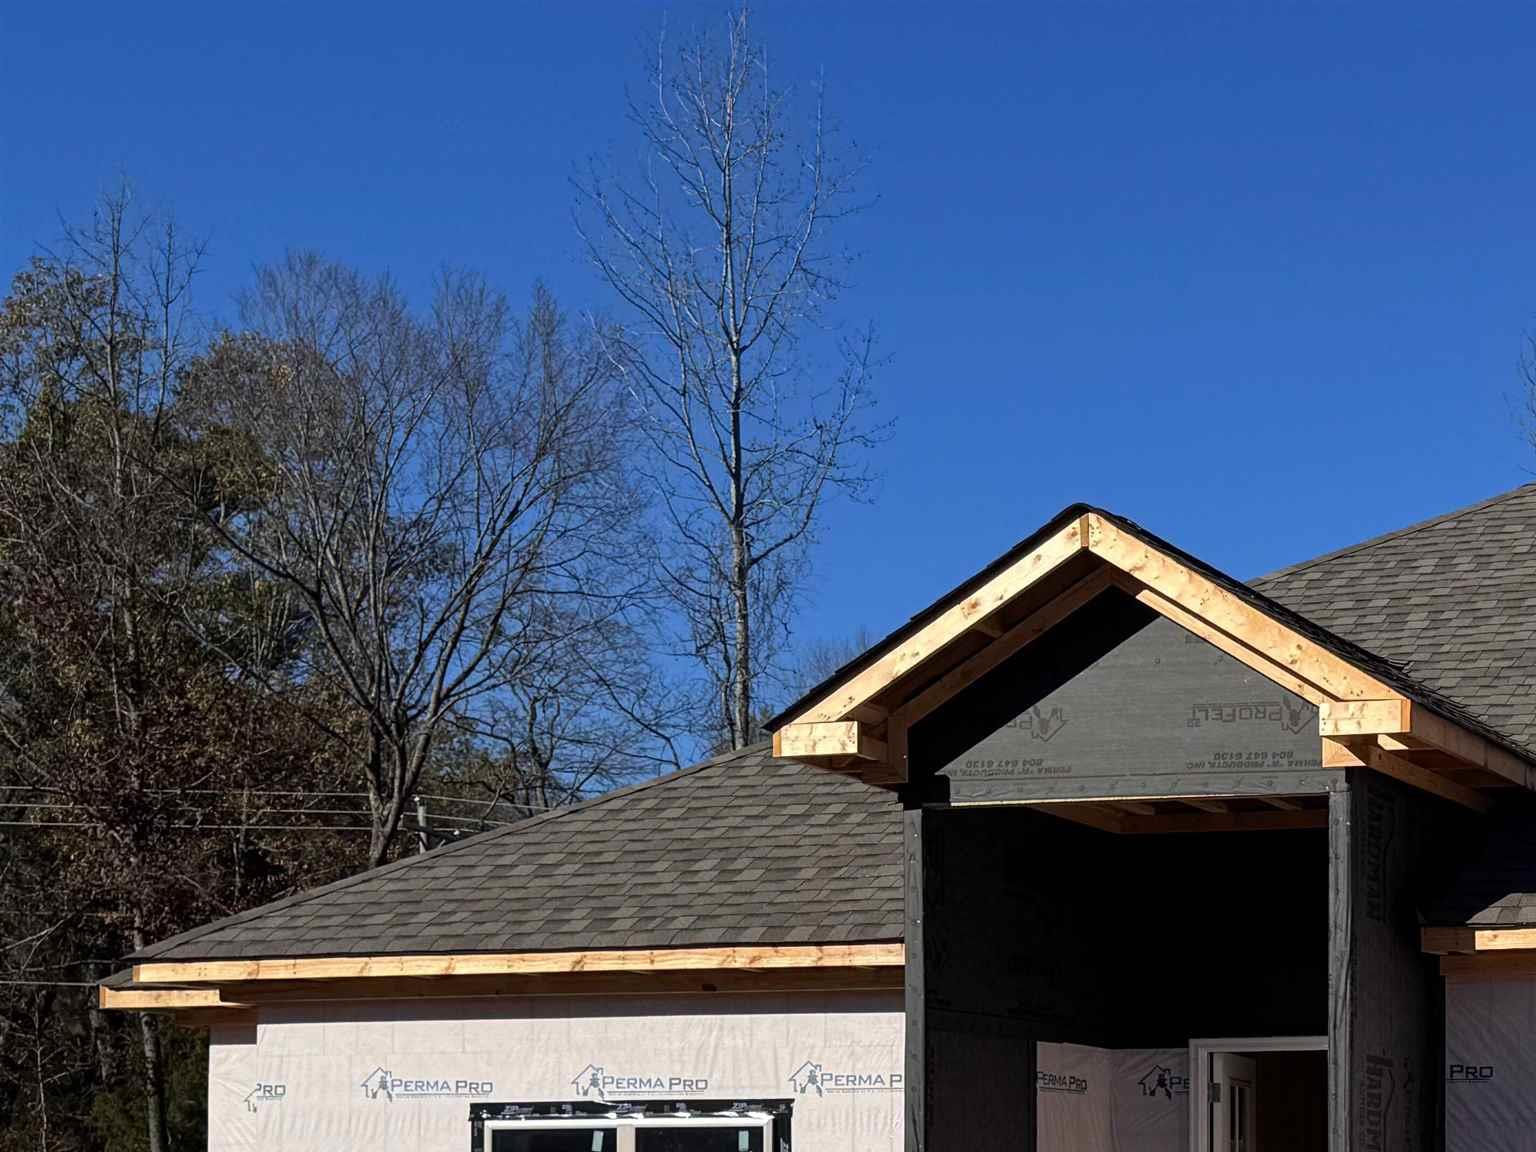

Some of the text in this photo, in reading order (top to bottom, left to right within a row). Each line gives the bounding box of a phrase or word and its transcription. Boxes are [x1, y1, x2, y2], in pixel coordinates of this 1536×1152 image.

[820, 1071, 884, 1088] PERMA
[1449, 1064, 1494, 1079] PRO
[390, 1079, 493, 1094] PERMA PRO
[602, 1075, 708, 1092] PERMA PRO
